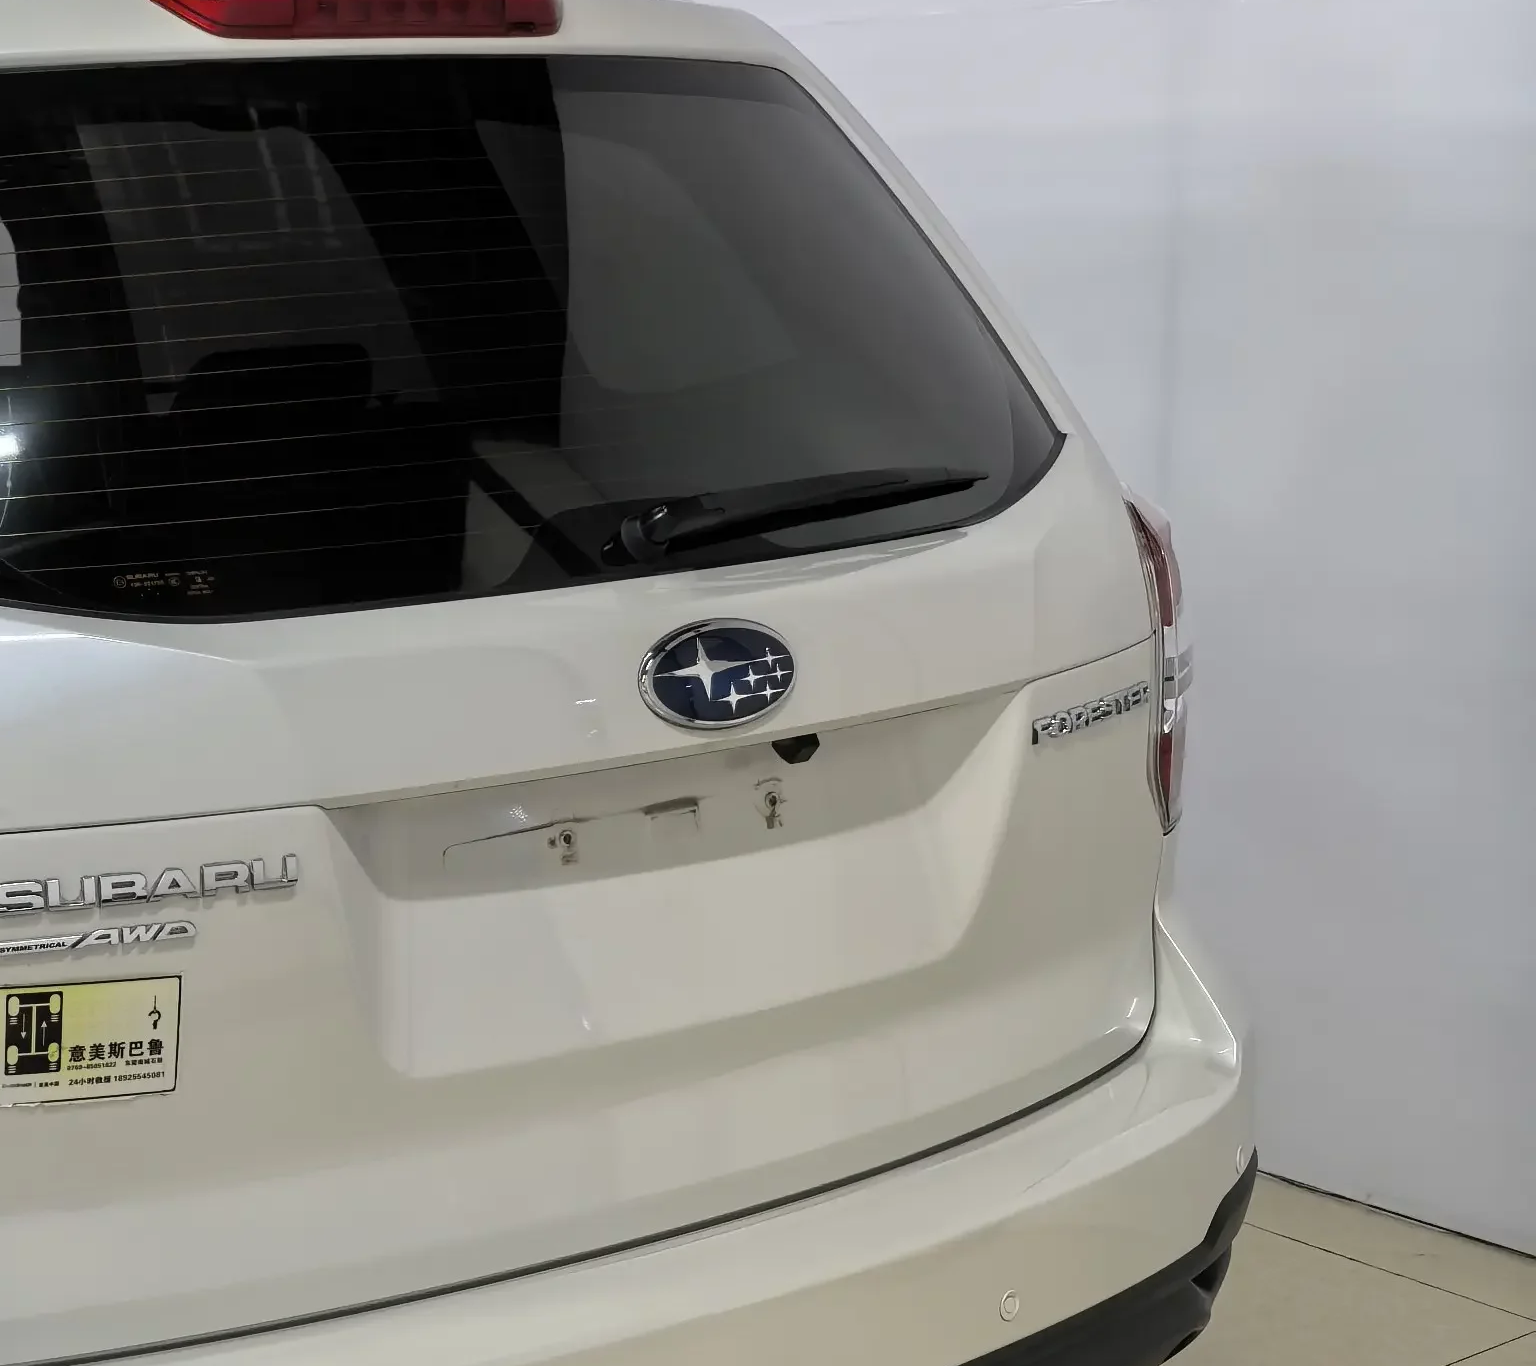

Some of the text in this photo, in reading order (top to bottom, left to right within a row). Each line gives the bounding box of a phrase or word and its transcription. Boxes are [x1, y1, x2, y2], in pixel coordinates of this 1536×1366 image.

[0, 920, 197, 954] SYMMETRICAL AWD
[68, 1038, 164, 1062] 意美斯巴鲁
